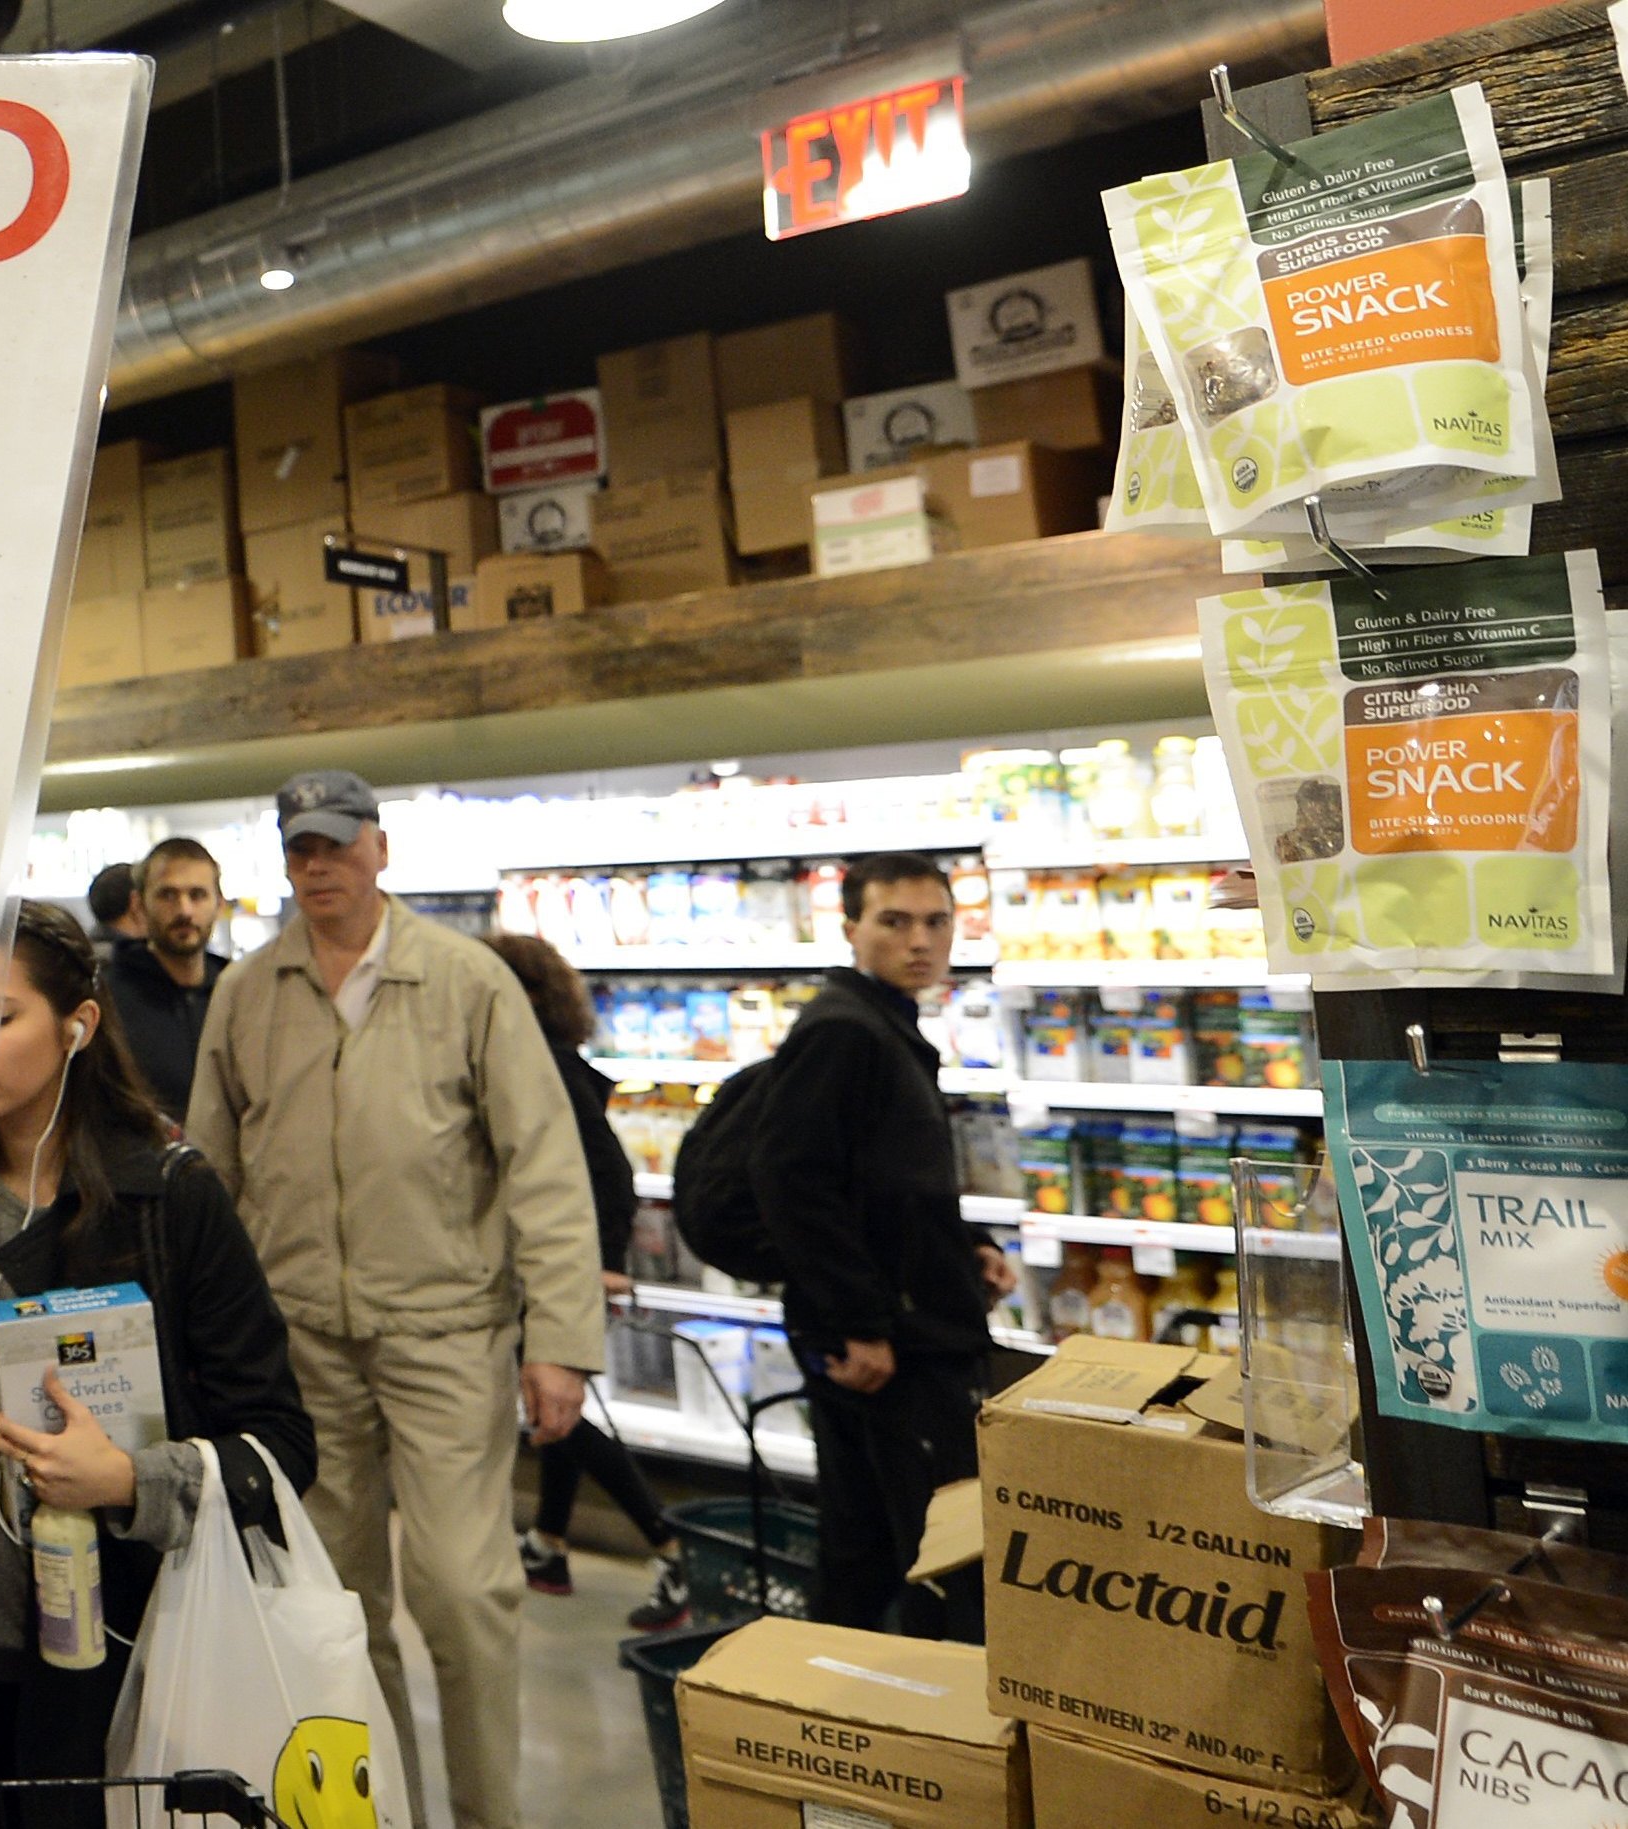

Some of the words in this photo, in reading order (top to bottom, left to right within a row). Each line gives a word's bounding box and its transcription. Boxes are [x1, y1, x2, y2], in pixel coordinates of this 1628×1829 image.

[785, 84, 942, 225] EXIT
[1261, 184, 1307, 205] Gluten
[1309, 179, 1322, 191] &
[1324, 166, 1361, 187] Dairy
[1364, 157, 1396, 174] Free
[1266, 207, 1300, 227] High
[1302, 200, 1317, 215] in
[1320, 191, 1355, 210] Fiber
[1357, 187, 1370, 199] &
[1370, 169, 1427, 195] Vitamin
[1428, 165, 1441, 178] C
[1271, 229, 1291, 242] No
[1294, 213, 1347, 237] Refined
[1349, 204, 1392, 223] Sugar
[1275, 235, 1340, 263] CITRUS
[1345, 225, 1392, 242] CHIA
[1277, 236, 1385, 274] SUPERFOOD
[1286, 271, 1389, 310] POWER
[1291, 280, 1450, 337] SNACK
[1300, 335, 1386, 364] BITE-SIZED
[1388, 325, 1474, 344] GOODNESS
[1433, 416, 1502, 437] NAVITAS
[375, 585, 469, 617] ECOVR
[1354, 616, 1401, 631] Gluten
[1405, 613, 1418, 624] &
[1421, 608, 1461, 624] Dairy
[1464, 605, 1497, 619] Free
[1357, 638, 1392, 654] High
[1395, 635, 1409, 648] in
[1413, 632, 1449, 646] Fiber
[1453, 630, 1465, 642] &
[1467, 626, 1526, 641] Vitamin
[1529, 624, 1541, 636] C
[1360, 663, 1381, 676] No
[1385, 655, 1439, 673] Refined
[1443, 652, 1486, 668] Sugar
[1366, 740, 1468, 767] POWER
[1366, 760, 1526, 799] SNACK
[1488, 913, 1568, 930] NAVITAS
[1477, 1158, 1510, 1172] Berry
[1522, 1160, 1557, 1172] Cacao
[1561, 1161, 1582, 1172] Nib
[1467, 1193, 1607, 1229] TRAIL
[1481, 1230, 1534, 1249] MIX
[1484, 1295, 1554, 1309] Antioxidant
[1557, 1299, 1621, 1313] Superfood
[63, 1344, 91, 1361] 365
[31, 1375, 133, 1403] Sdwich
[996, 1486, 1010, 1504] 6
[1017, 1490, 1124, 1530] CARTONS
[1147, 1520, 1186, 1546] 1/2
[1192, 1529, 1292, 1568] GALLON
[1000, 1529, 1286, 1651] Lactaid
[1494, 1630, 1517, 1645] THE
[998, 1676, 1055, 1709] STORE
[1058, 1693, 1146, 1737] BETWEEN
[1185, 1730, 1228, 1758] AND
[1463, 1683, 1491, 1702] Raw
[1494, 1692, 1559, 1720] Chocolate
[1562, 1711, 1594, 1731] Nibs
[800, 1721, 871, 1753] KEEP
[736, 1737, 943, 1802] REFRIGERATED
[1460, 1767, 1532, 1806] NIBS
[1204, 1789, 1282, 1825] 6-1/2
